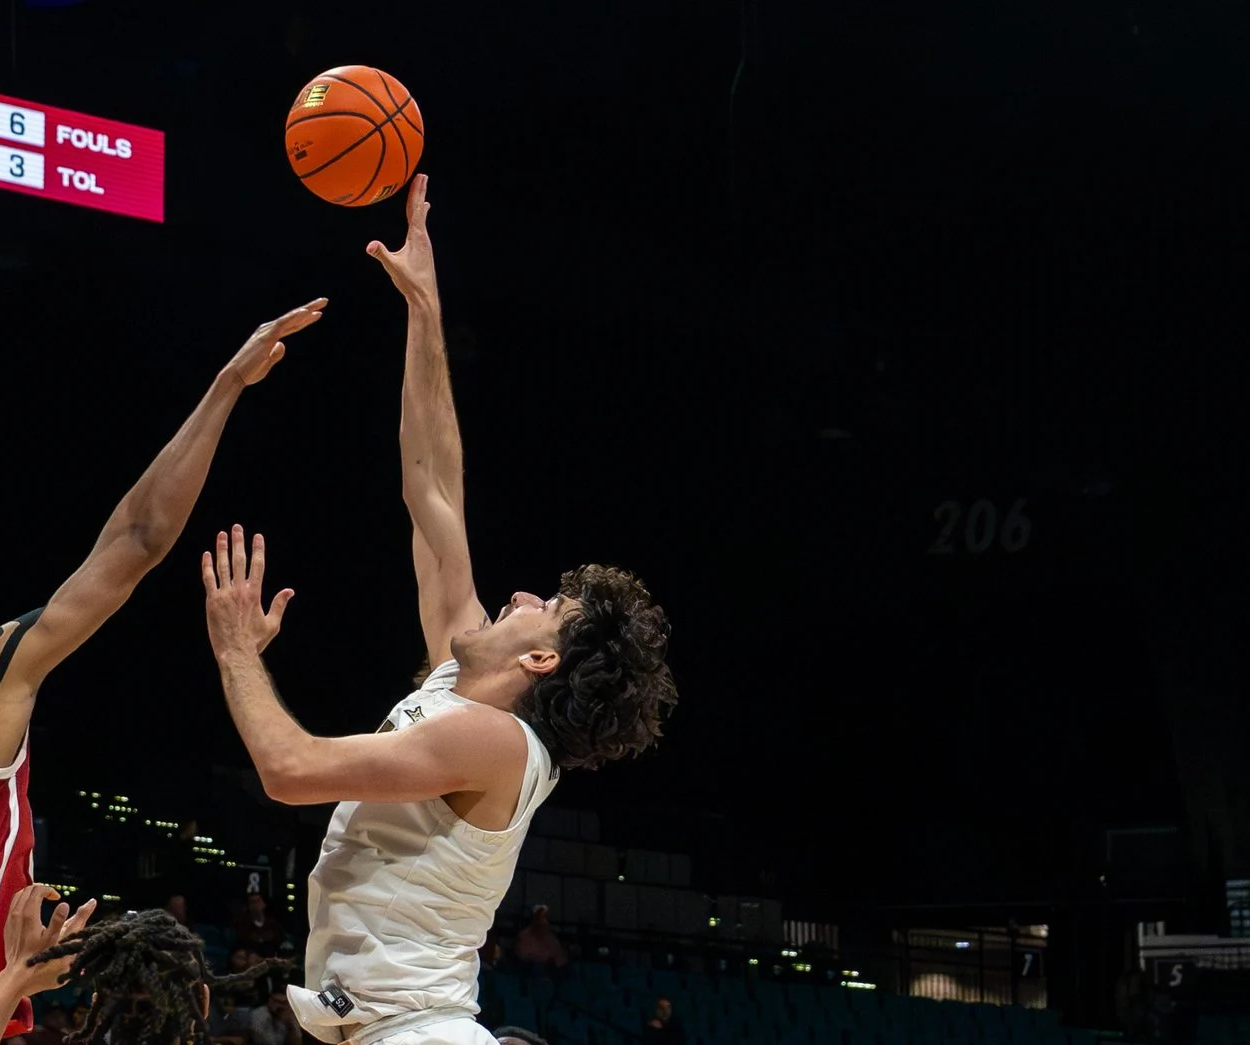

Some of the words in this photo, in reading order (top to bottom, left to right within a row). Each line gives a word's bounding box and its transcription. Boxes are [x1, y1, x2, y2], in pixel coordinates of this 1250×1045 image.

[9, 112, 25, 136] 6
[56, 124, 132, 159] FOULS
[9, 154, 25, 178] 3
[56, 166, 105, 194] TOL
[926, 497, 1032, 555] 206
[1169, 963, 1184, 987] 5
